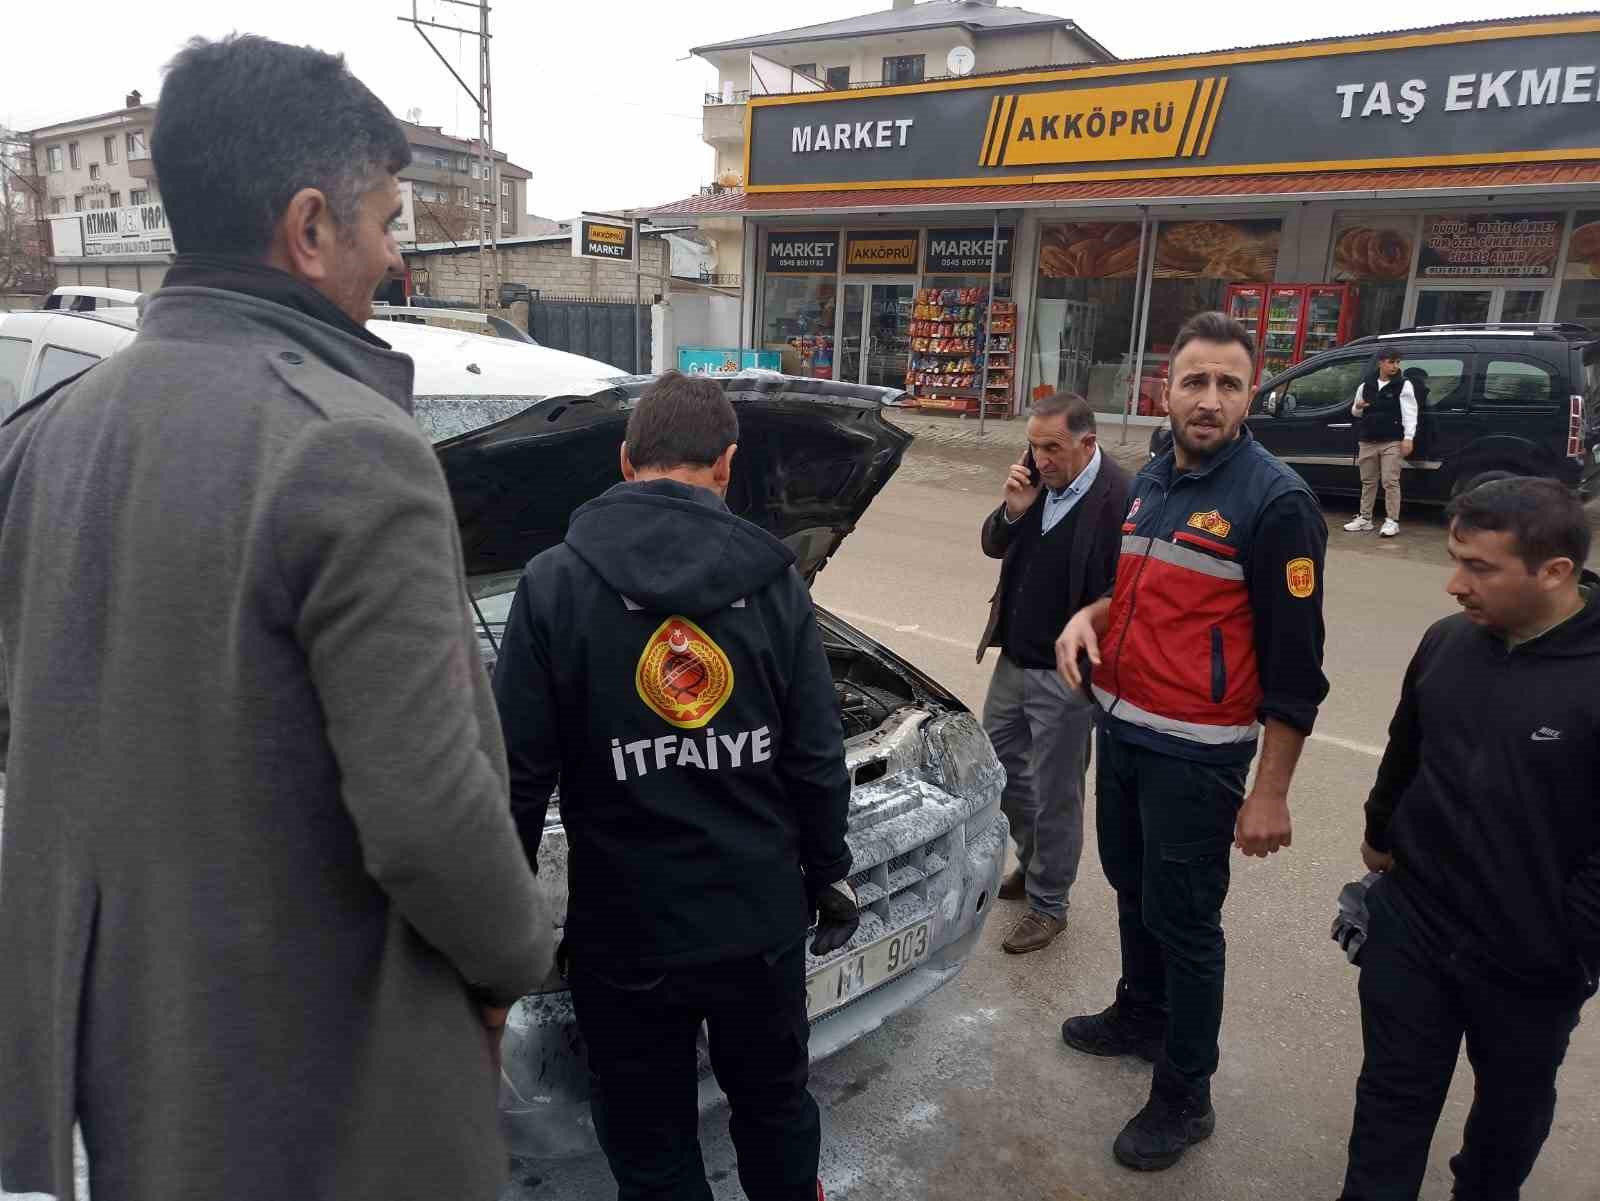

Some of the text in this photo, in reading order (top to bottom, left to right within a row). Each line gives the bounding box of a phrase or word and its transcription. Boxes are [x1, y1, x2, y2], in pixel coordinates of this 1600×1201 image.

[1336, 66, 1600, 123] TAŞ EKME
[1017, 102, 1175, 141] AKKÖPRÜ
[791, 119, 913, 153] MARKET
[86, 212, 118, 234] ATMAN
[589, 243, 624, 256] MARKET
[771, 242, 834, 257] MARKET
[854, 245, 910, 259] AKKÖPRÜ
[931, 240, 1008, 256] MARKET
[611, 725, 771, 781] İTFAİYE
[887, 924, 928, 973] 903
